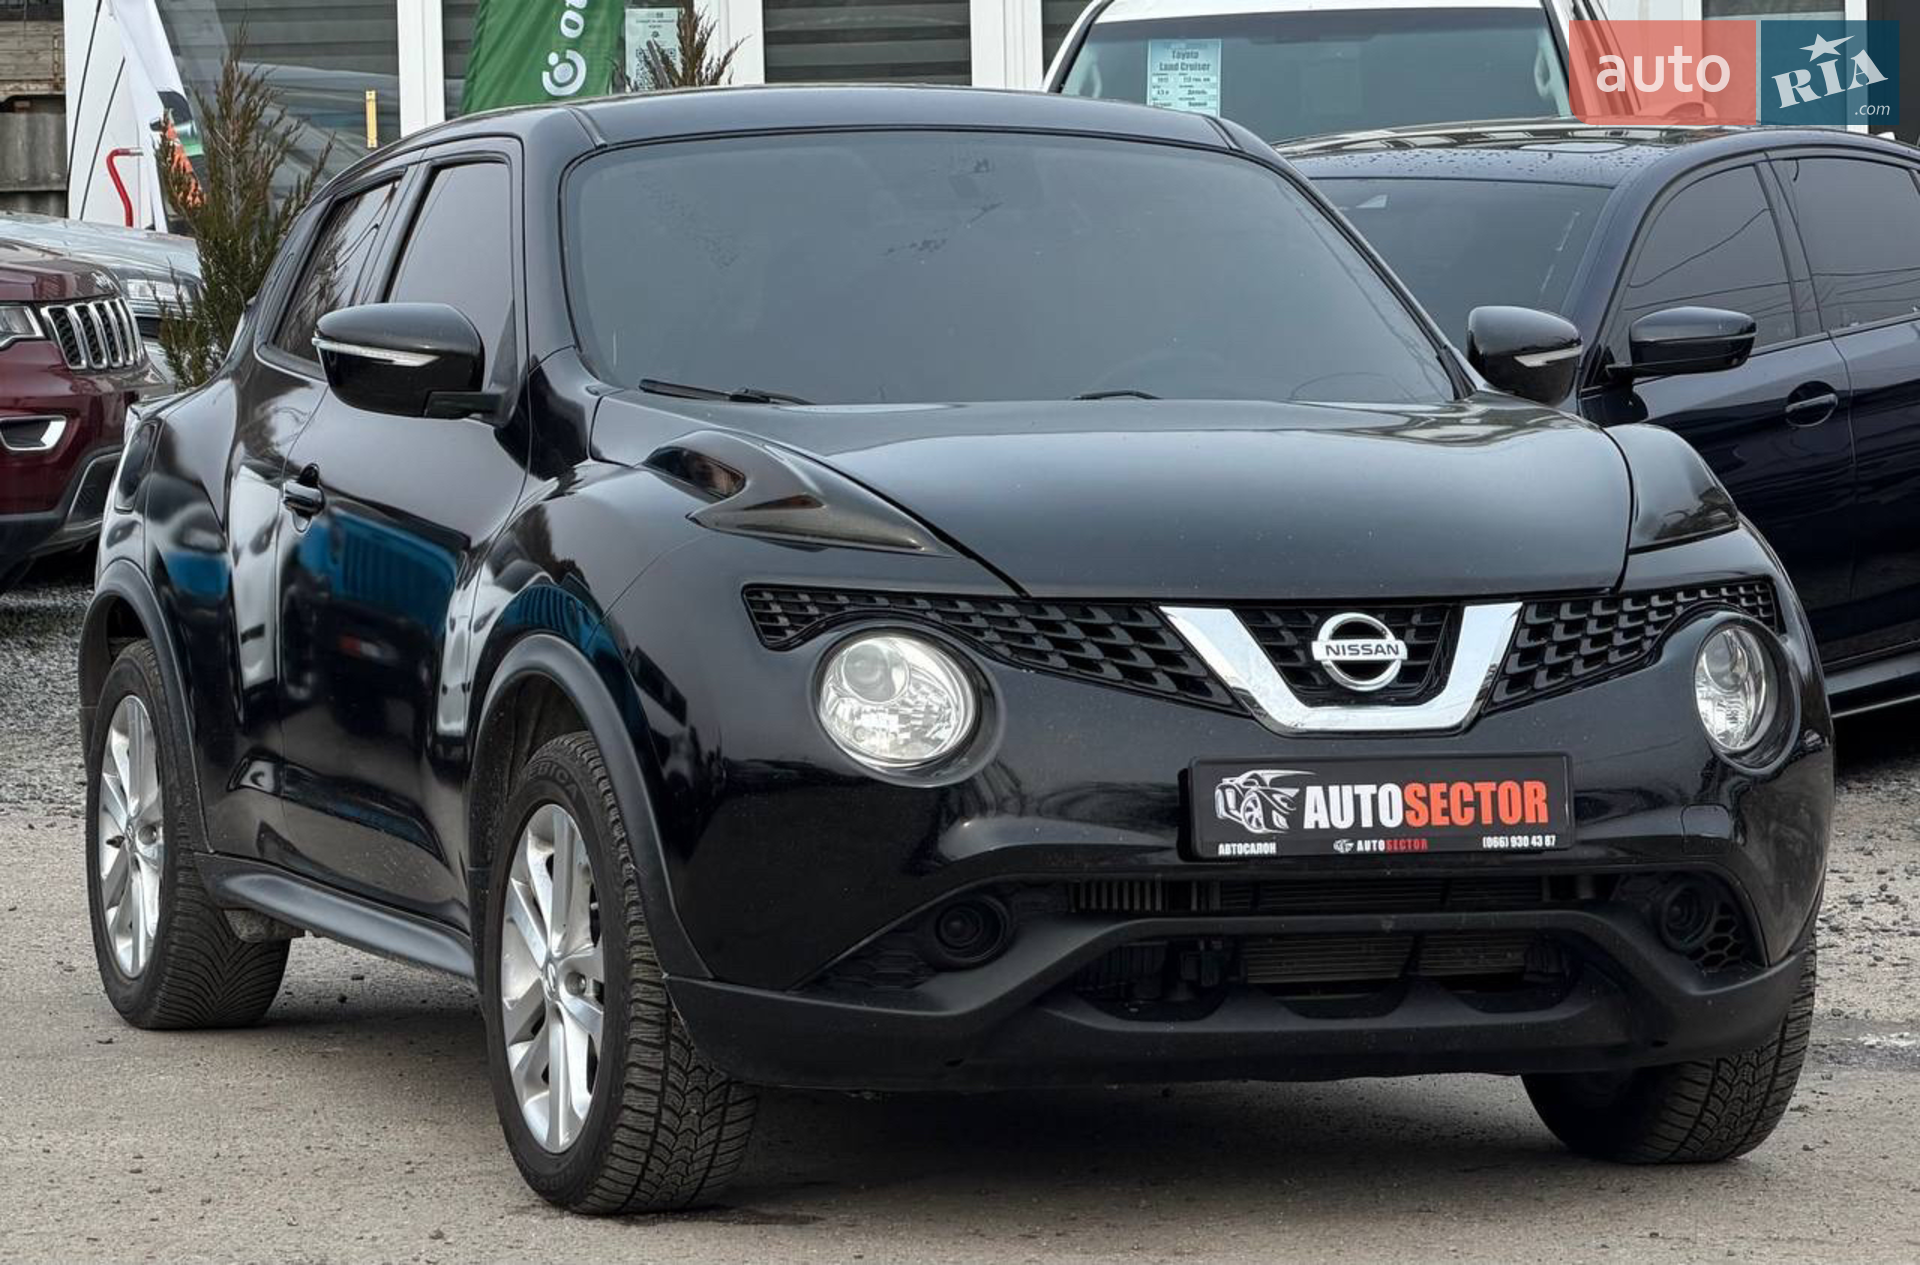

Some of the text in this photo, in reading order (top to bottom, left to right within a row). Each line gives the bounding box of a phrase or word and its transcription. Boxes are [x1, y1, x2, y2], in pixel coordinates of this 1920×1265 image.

[1172, 51, 1199, 60] Toyota
[1159, 62, 1210, 71] Land Cruiser
[1325, 643, 1400, 656] NISSAN
[1303, 780, 1549, 829] AUTOSECTOR
[1217, 841, 1277, 856] АВТОСАЛОН
[1356, 838, 1428, 852] AUTOSECTOR
[1482, 834, 1556, 849] (066) 930 43 87
